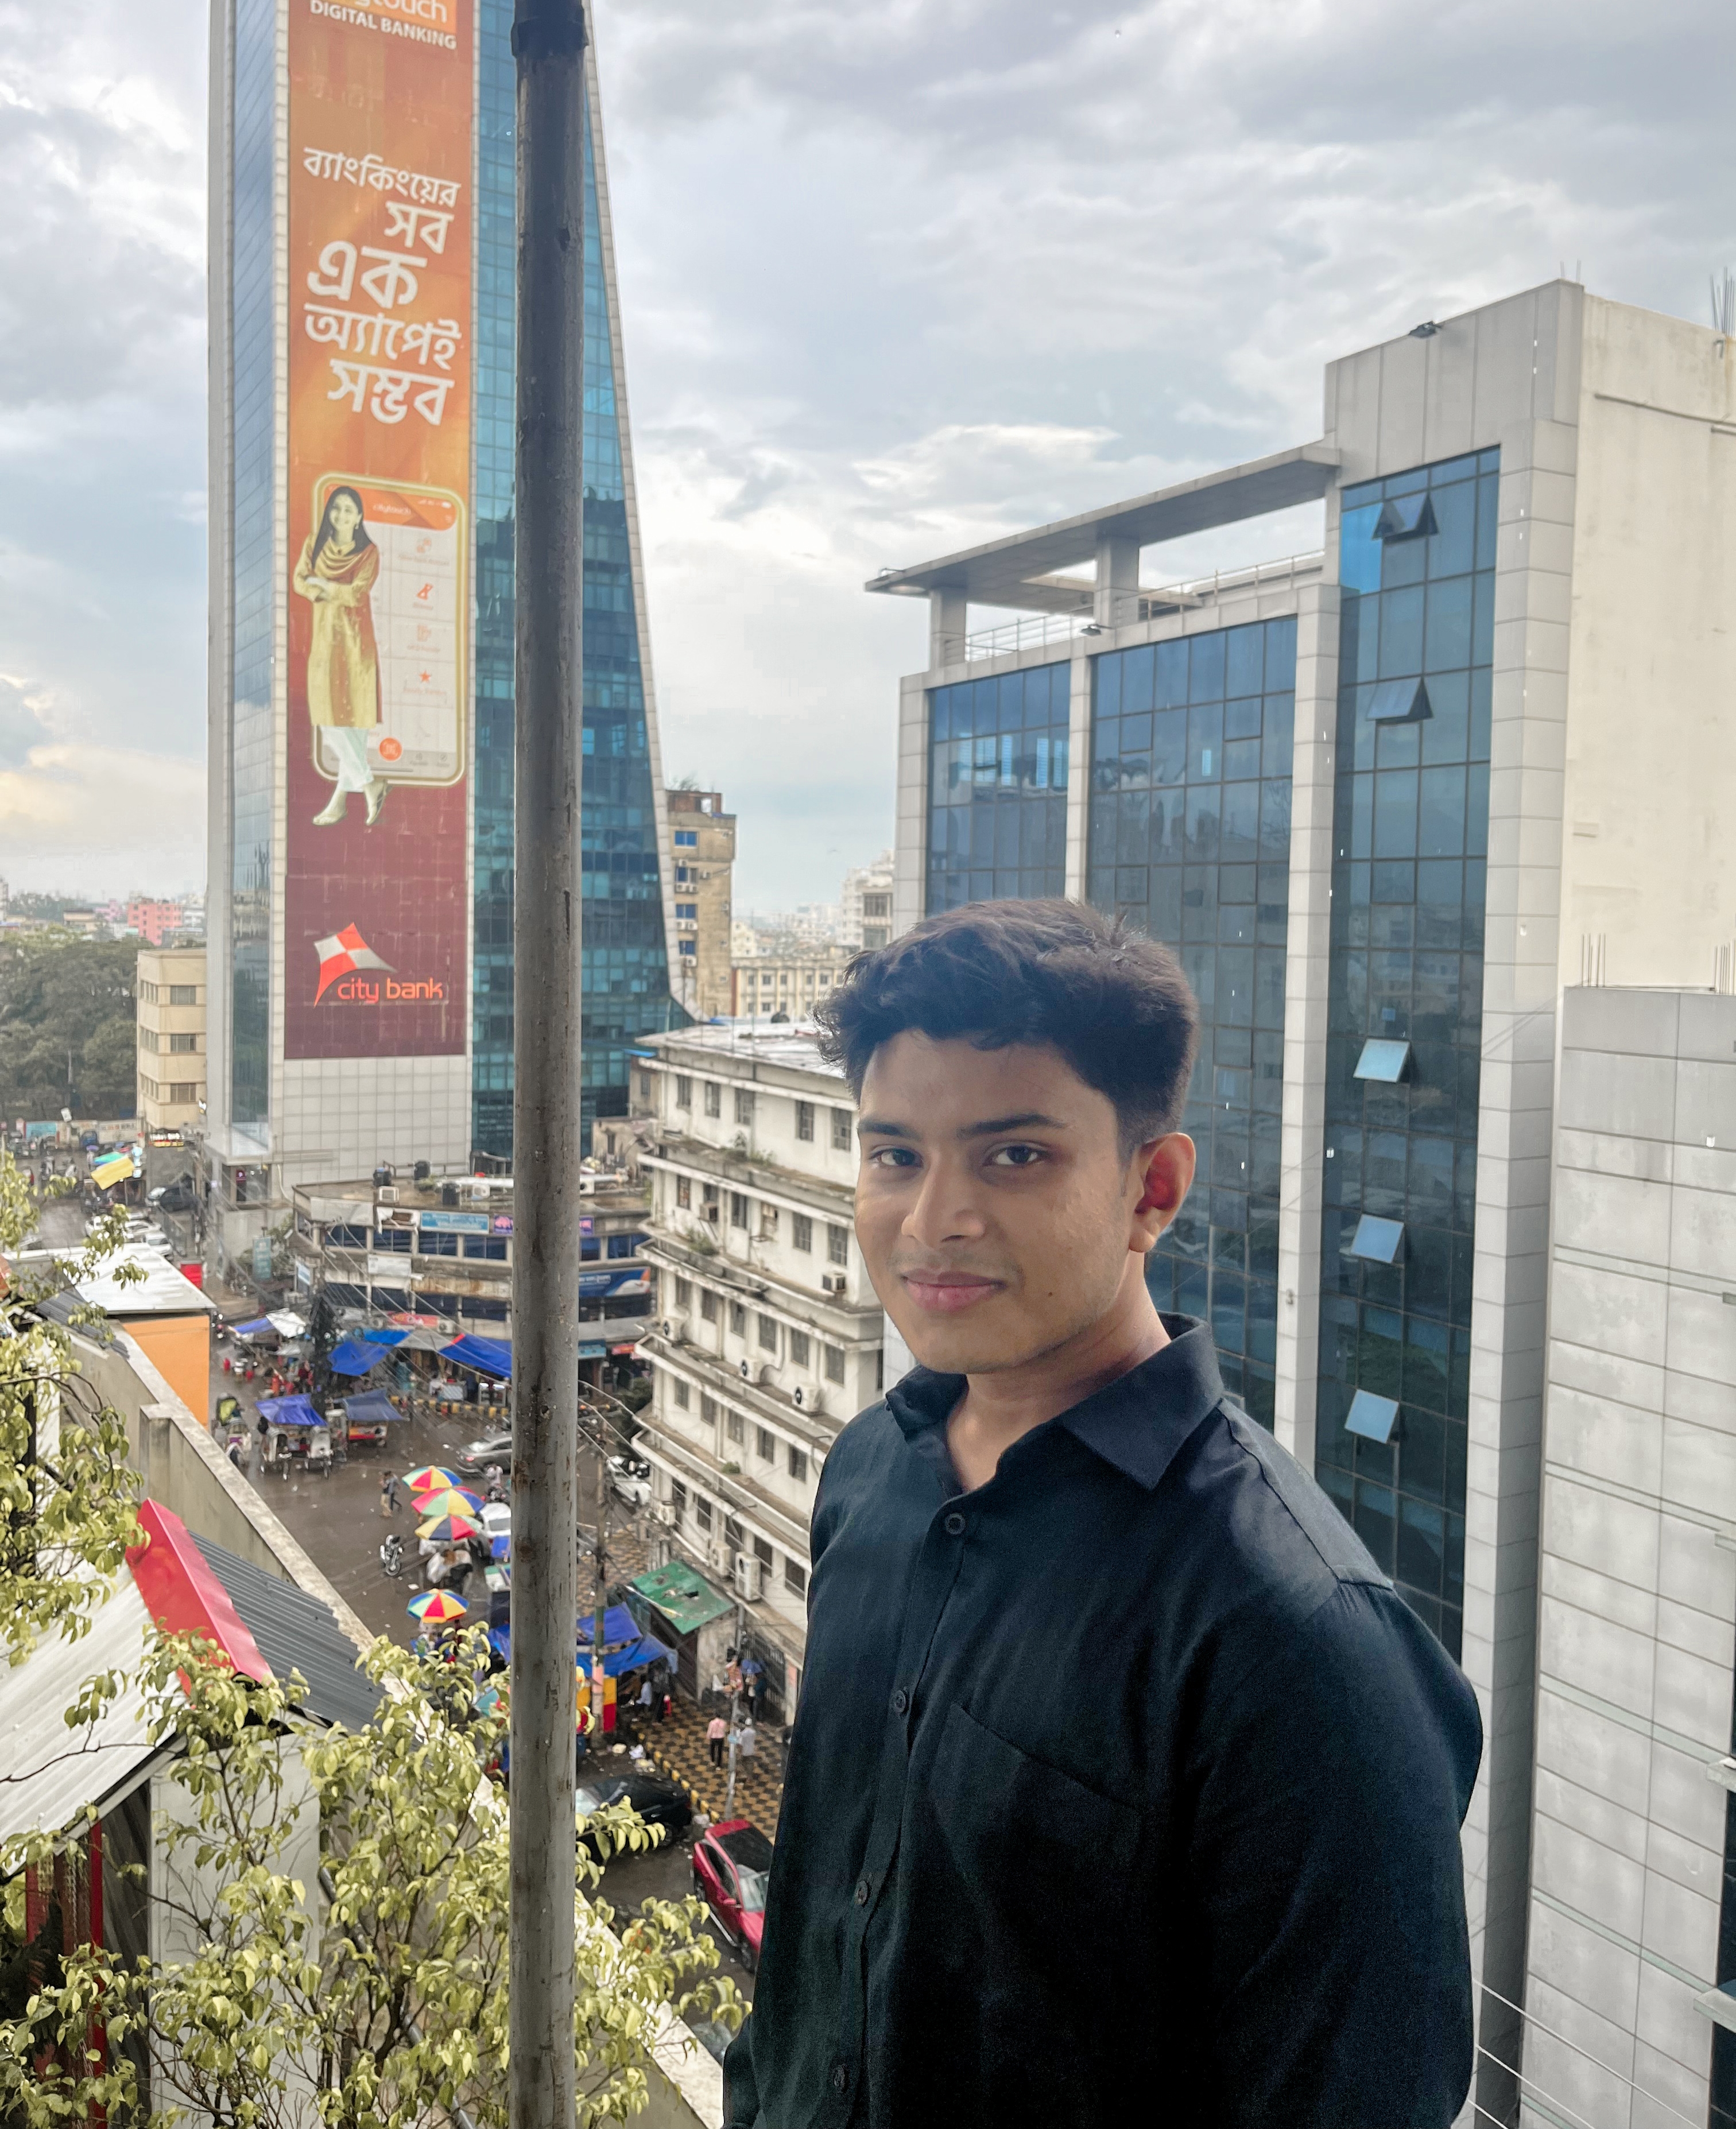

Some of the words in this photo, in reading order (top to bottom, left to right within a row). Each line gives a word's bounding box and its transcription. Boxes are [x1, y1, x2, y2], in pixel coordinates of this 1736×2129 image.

[310, 0, 378, 30] DIGITAL
[379, 17, 457, 50] BANKING
[303, 146, 462, 208] ব্যাংকিংয়ের
[383, 200, 455, 254] সব
[307, 240, 428, 309] এক
[304, 303, 462, 371] অ্যাপেই
[327, 358, 455, 425] সম্ভব
[338, 977, 379, 1003] city
[387, 977, 443, 999] bank
